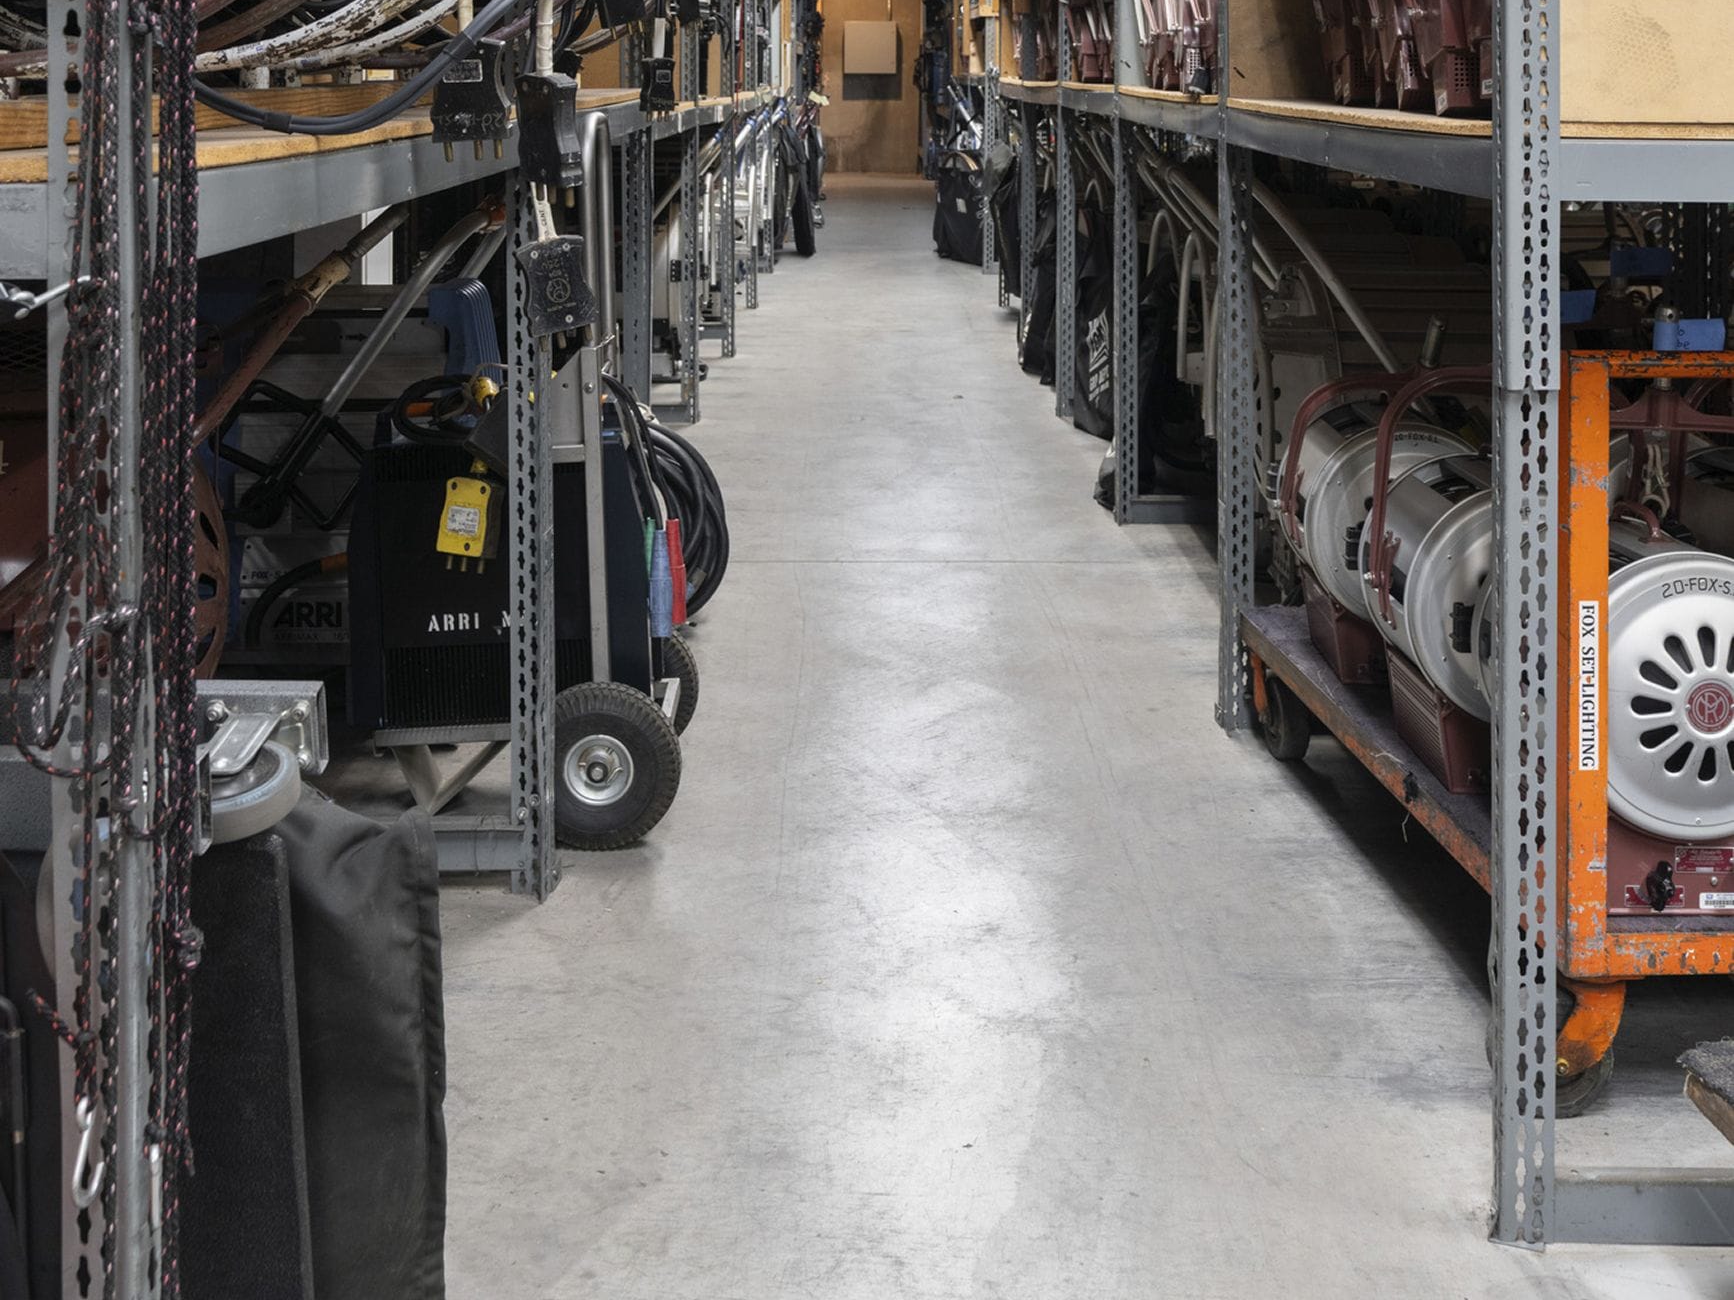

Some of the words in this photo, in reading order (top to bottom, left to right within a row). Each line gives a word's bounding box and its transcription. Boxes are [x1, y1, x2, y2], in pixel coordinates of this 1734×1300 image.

[273, 601, 342, 628] ARRI
[428, 611, 480, 633] ARRI
[1581, 605, 1596, 638] FOX
